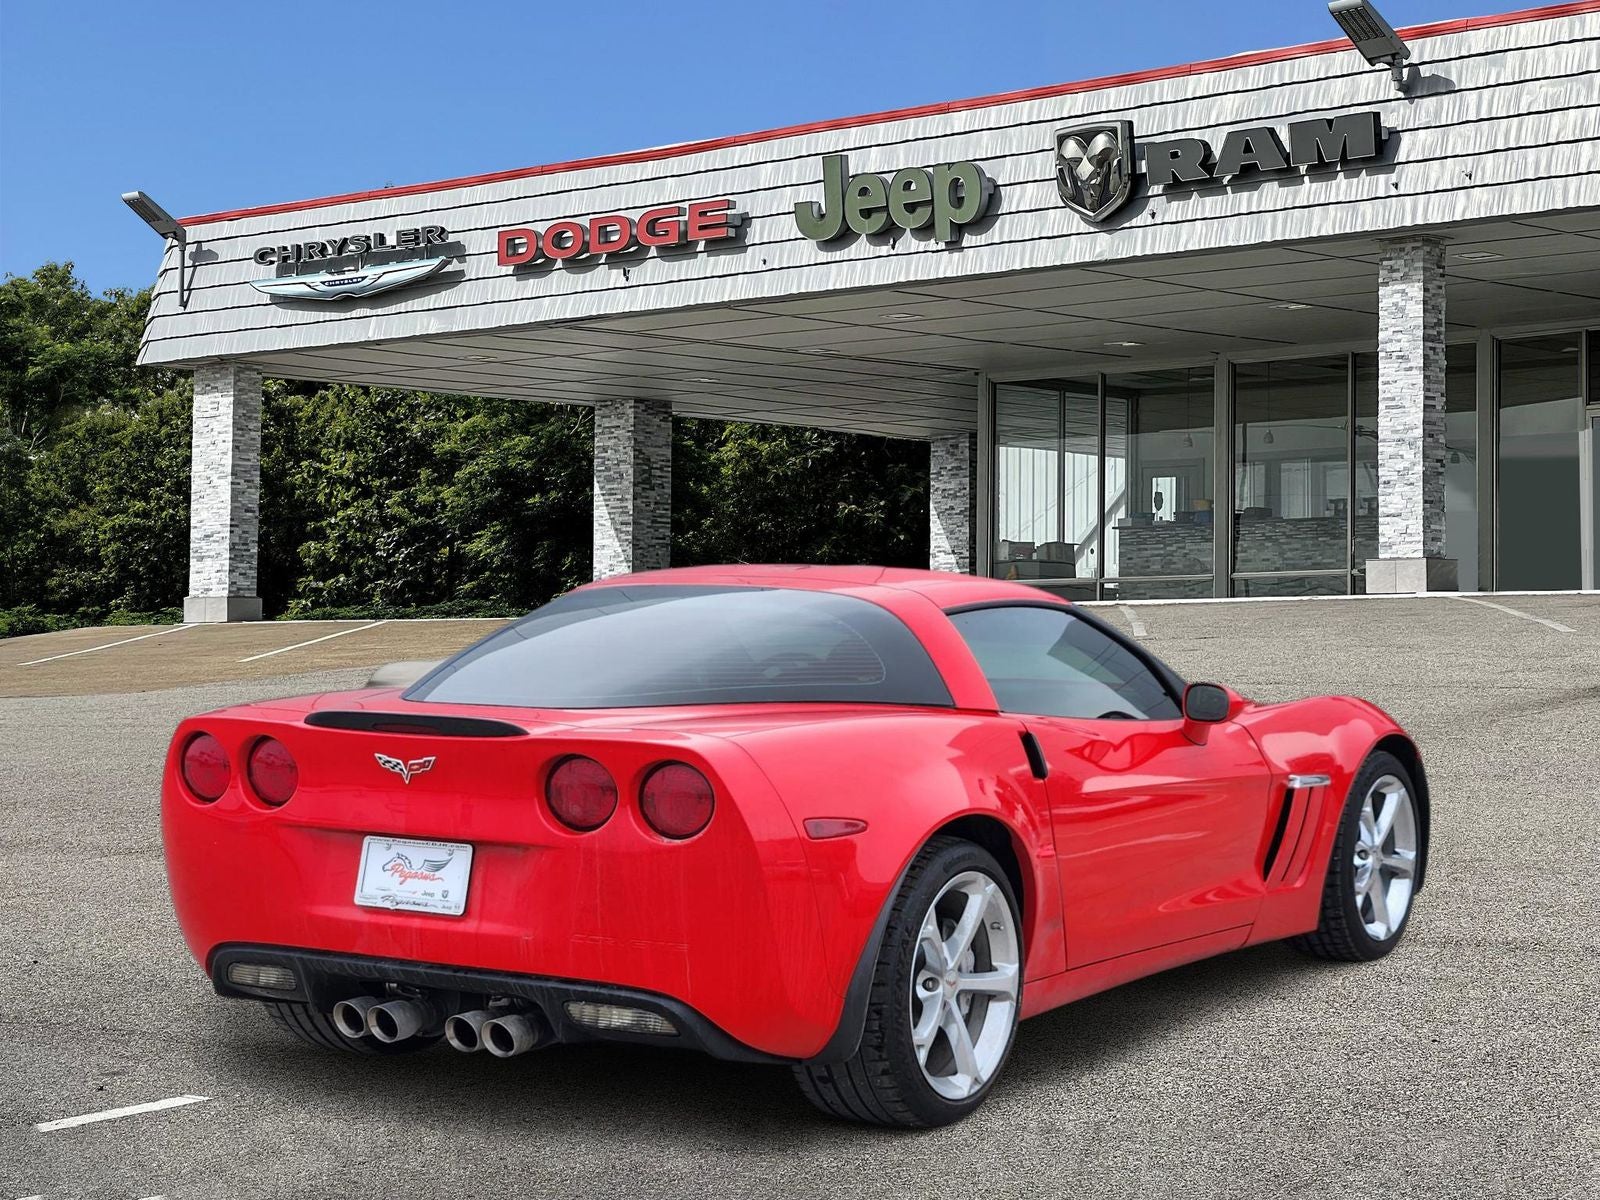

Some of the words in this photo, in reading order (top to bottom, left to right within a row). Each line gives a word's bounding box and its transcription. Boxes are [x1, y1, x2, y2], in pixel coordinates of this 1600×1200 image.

[1145, 112, 1379, 186] RAM
[795, 155, 984, 242] Jeep
[253, 225, 447, 266] CHRYSLER
[498, 200, 735, 266] DODGE
[324, 277, 363, 286] CHRYSLER
[391, 863, 445, 885] Pegasus
